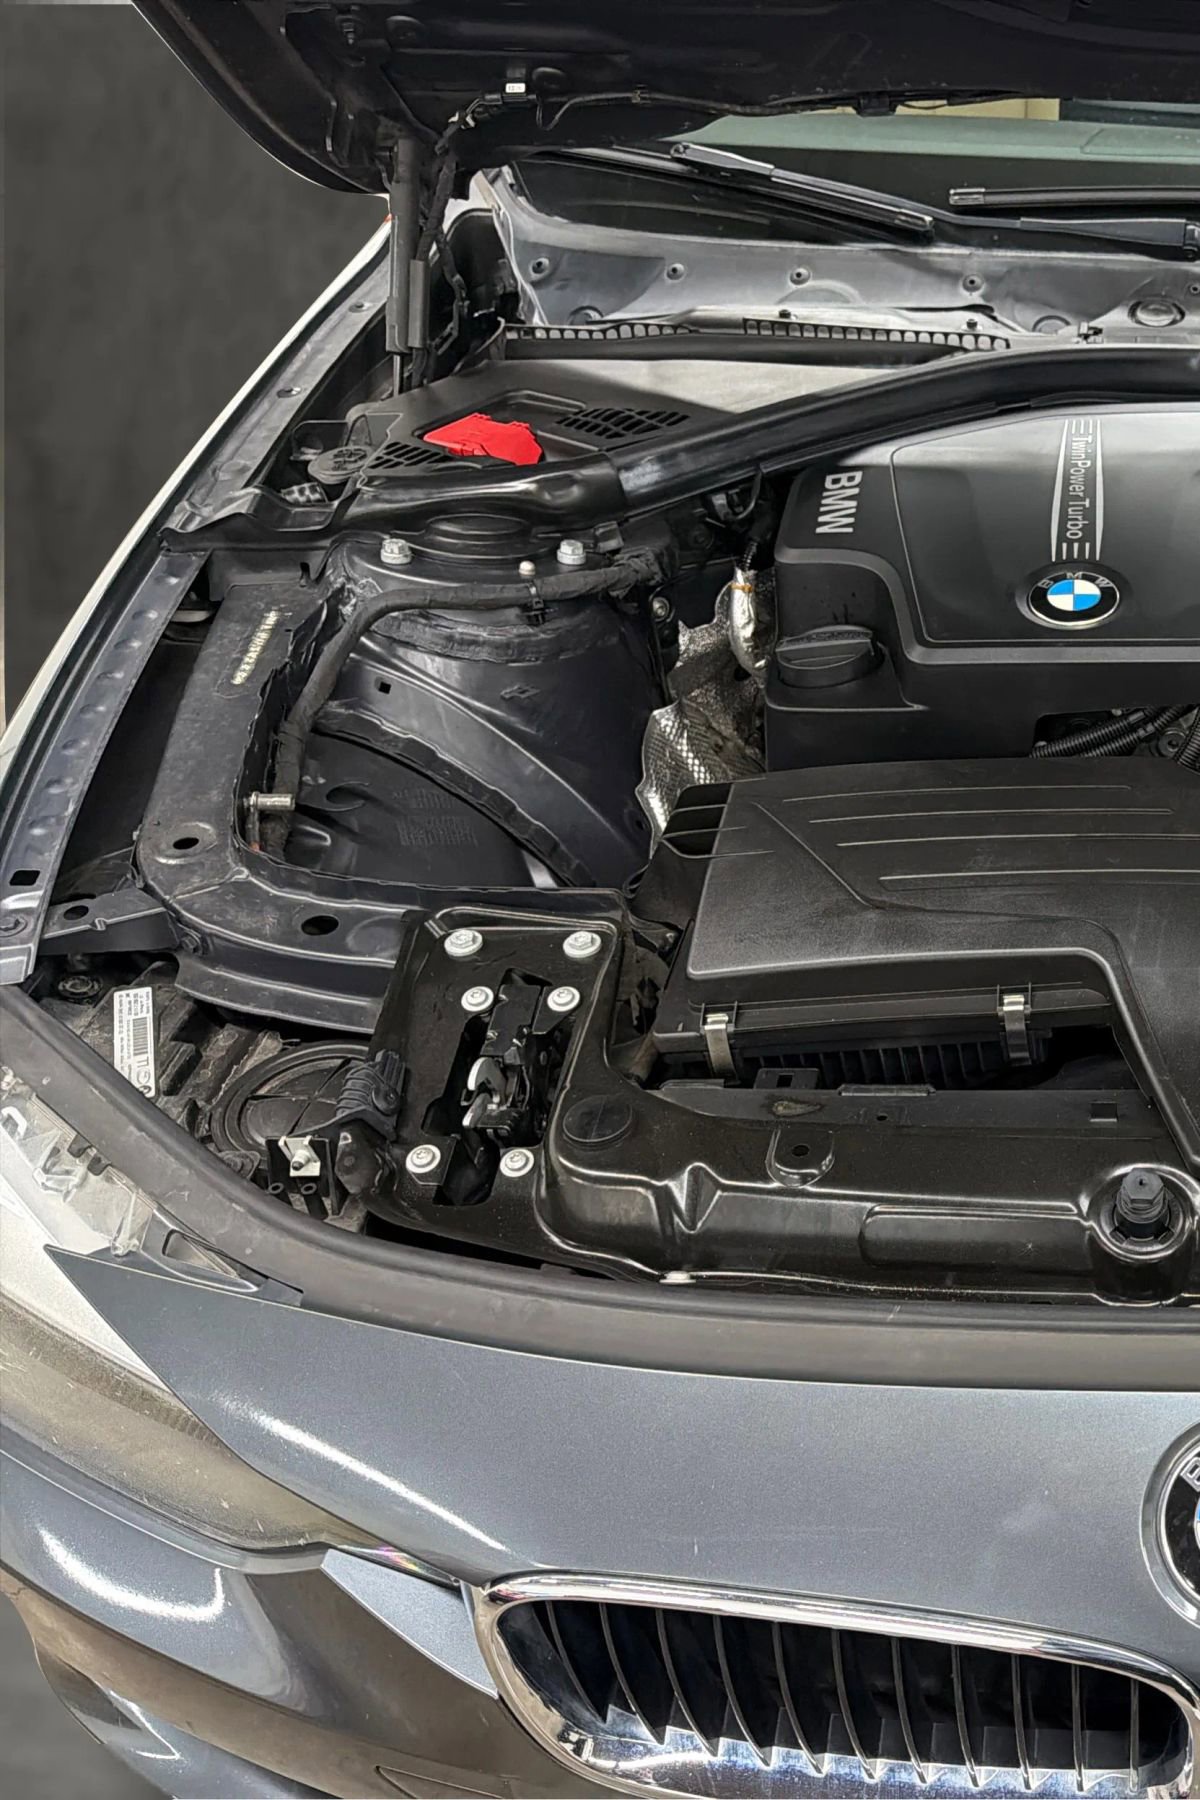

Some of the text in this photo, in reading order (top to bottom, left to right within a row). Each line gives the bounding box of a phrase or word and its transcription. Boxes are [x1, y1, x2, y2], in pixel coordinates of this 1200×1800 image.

[815, 470, 864, 534] BMW
[1065, 434, 1092, 540] TwinPower Turbo
